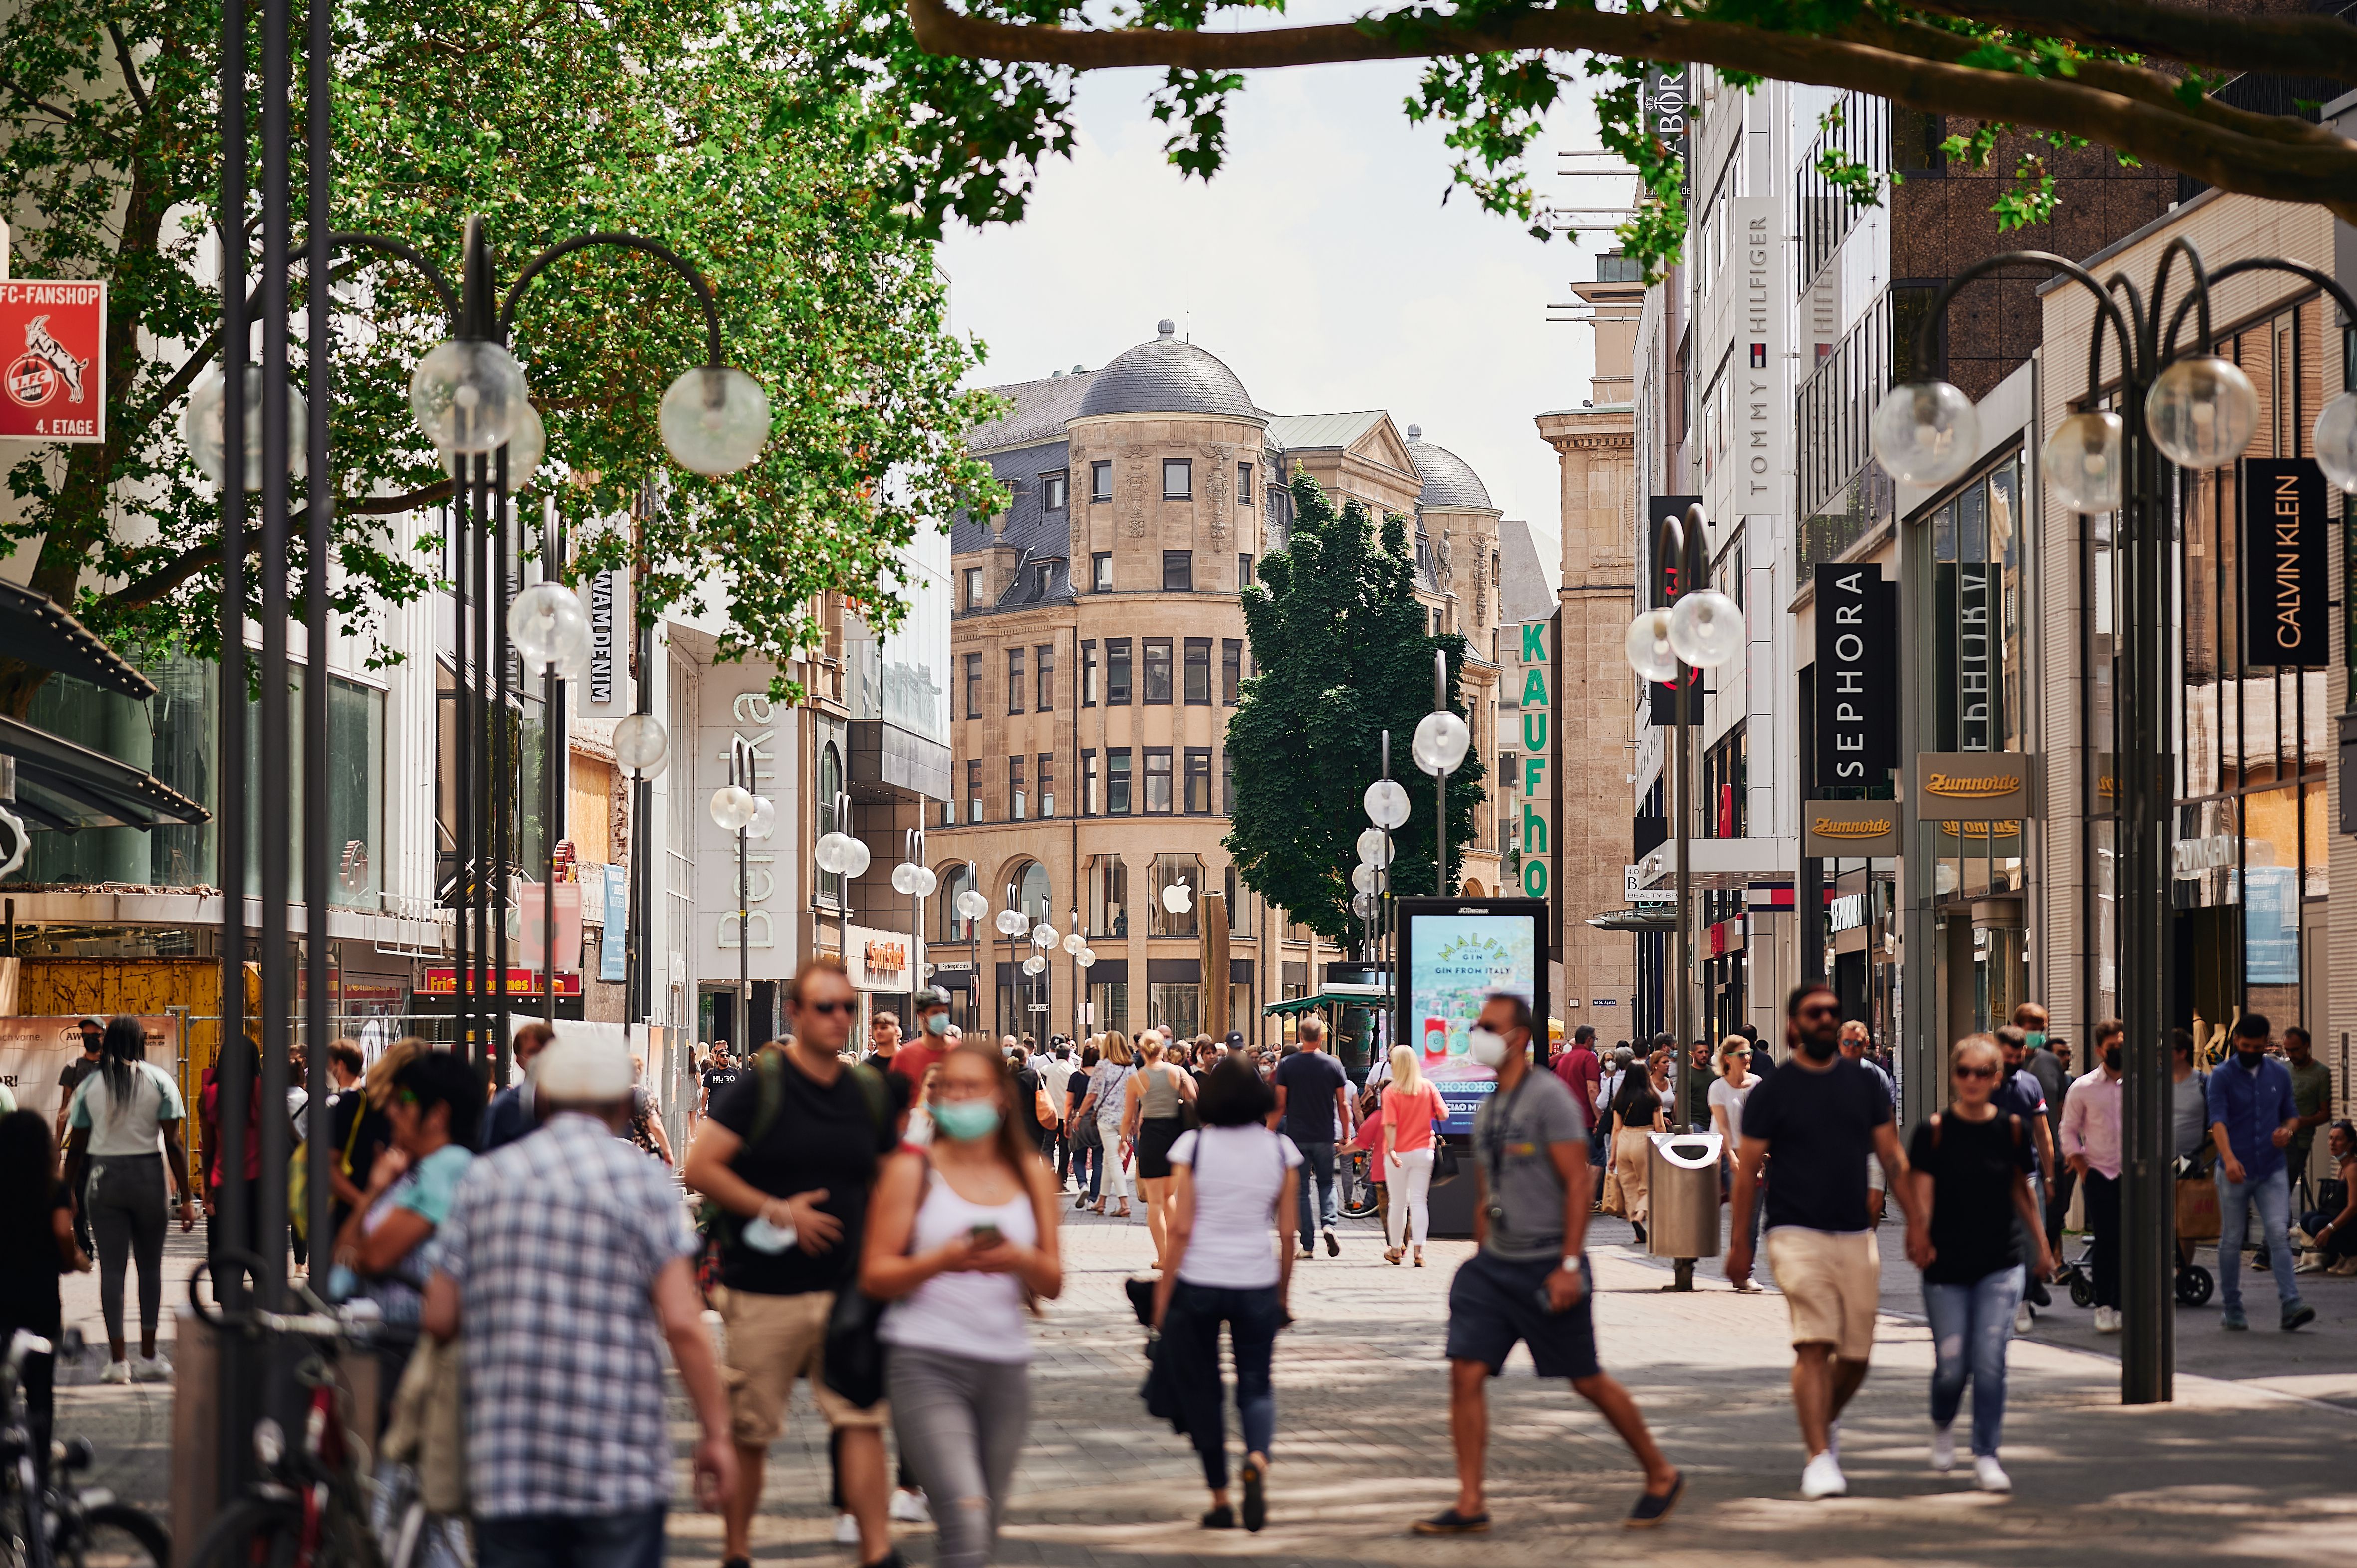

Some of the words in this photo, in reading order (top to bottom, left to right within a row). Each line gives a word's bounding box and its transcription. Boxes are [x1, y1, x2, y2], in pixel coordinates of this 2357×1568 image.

[1659, 71, 1684, 173] ABOR
[0, 285, 99, 305] FC-FANSHOP
[1749, 216, 1767, 333] HILFIGER
[35, 419, 49, 434] 4.
[52, 419, 94, 435] ETAGE
[1750, 380, 1767, 495] TOMMY
[2275, 475, 2300, 546] KLEIN
[2276, 553, 2301, 648] CALVIN
[1835, 572, 1864, 778] SEPHORA
[1521, 624, 1549, 898] KAUFhO
[1924, 773, 2020, 798] Zumnorde
[718, 692, 775, 948] Berka
[1812, 817, 1892, 839] Zumnorde
[1437, 932, 1508, 962] MALFY
[1831, 893, 1863, 933] SEPHORA
